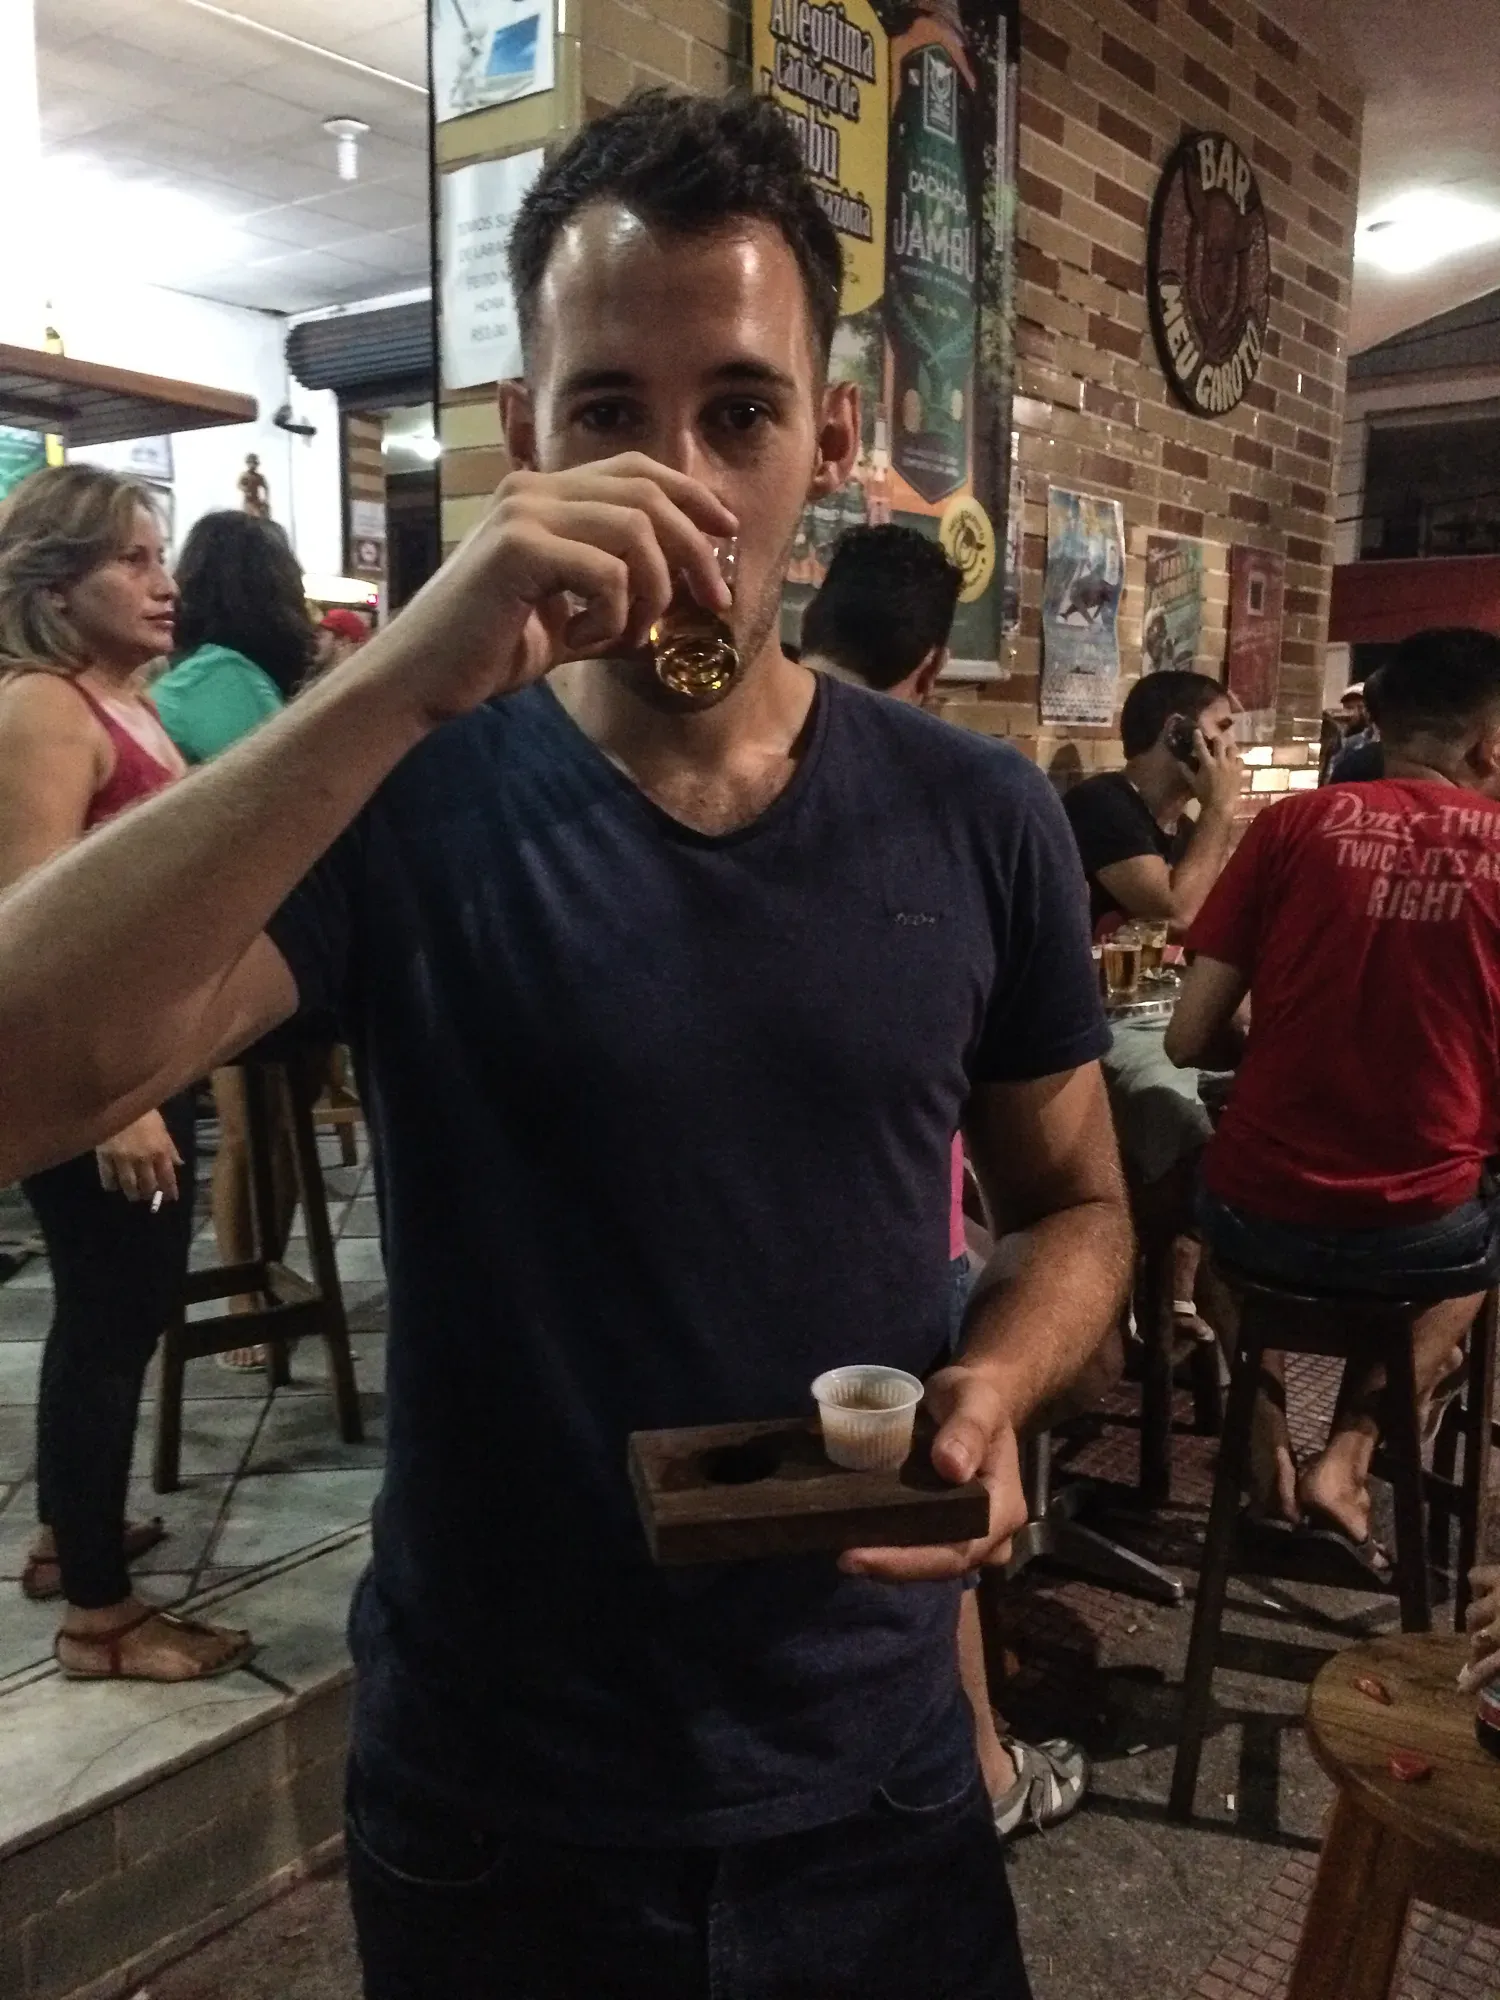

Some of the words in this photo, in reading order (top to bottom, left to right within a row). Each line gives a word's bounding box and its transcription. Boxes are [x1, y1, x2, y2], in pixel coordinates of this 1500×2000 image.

[776, 39, 839, 114] Cachaça
[840, 72, 859, 120] de
[814, 189, 873, 241] azônia
[1197, 138, 1250, 216] BAR
[1159, 284, 1200, 381] MEU
[1195, 319, 1261, 413] GAROTO
[1366, 875, 1472, 922] RIGHT
